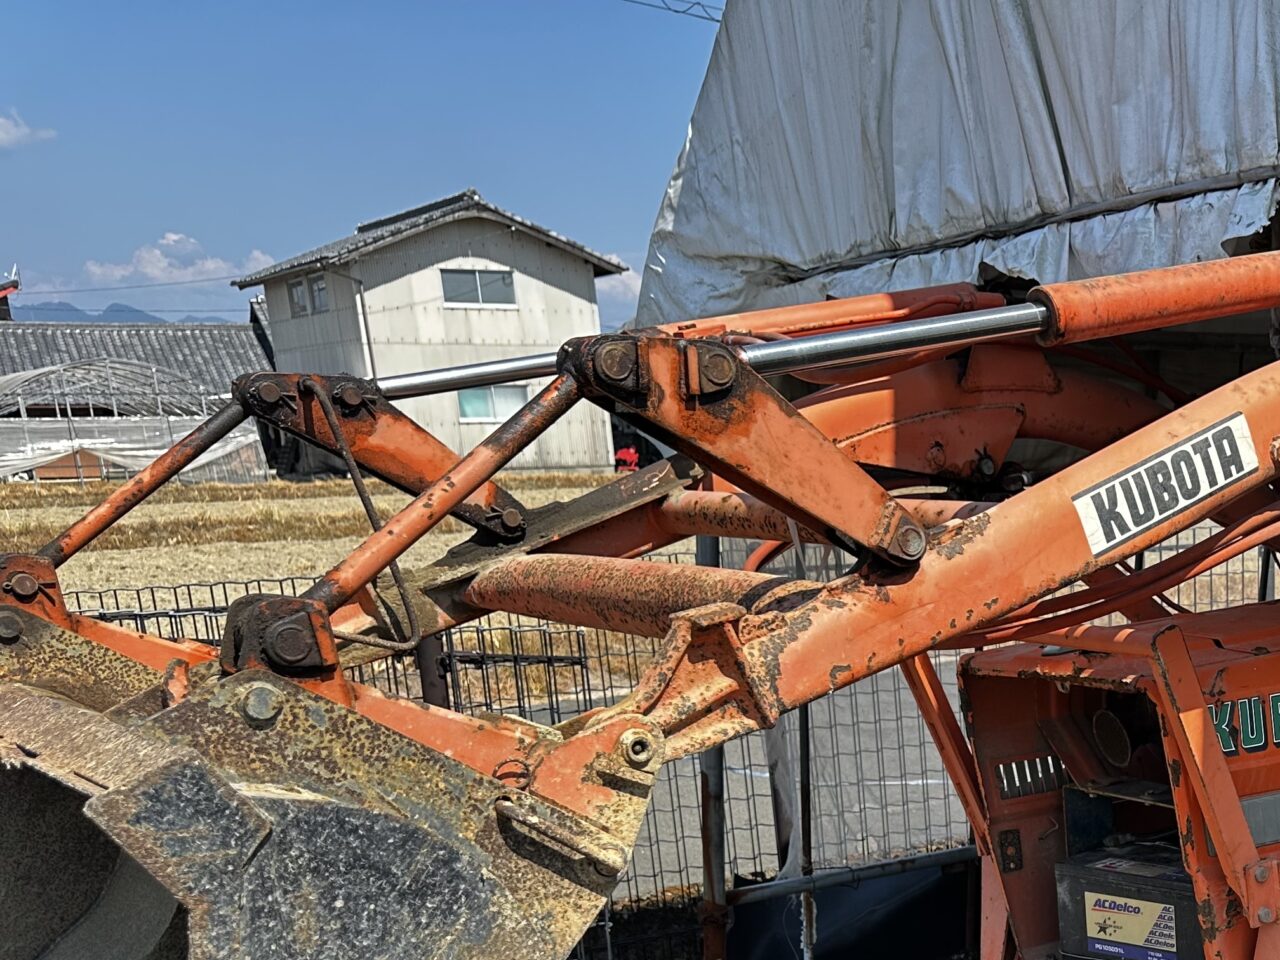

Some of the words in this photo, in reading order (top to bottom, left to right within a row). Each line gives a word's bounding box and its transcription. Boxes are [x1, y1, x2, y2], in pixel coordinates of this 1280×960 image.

[1090, 425, 1245, 544] KUBOTA
[1093, 898, 1141, 914] ACDelco
[1161, 905, 1174, 913] AC
